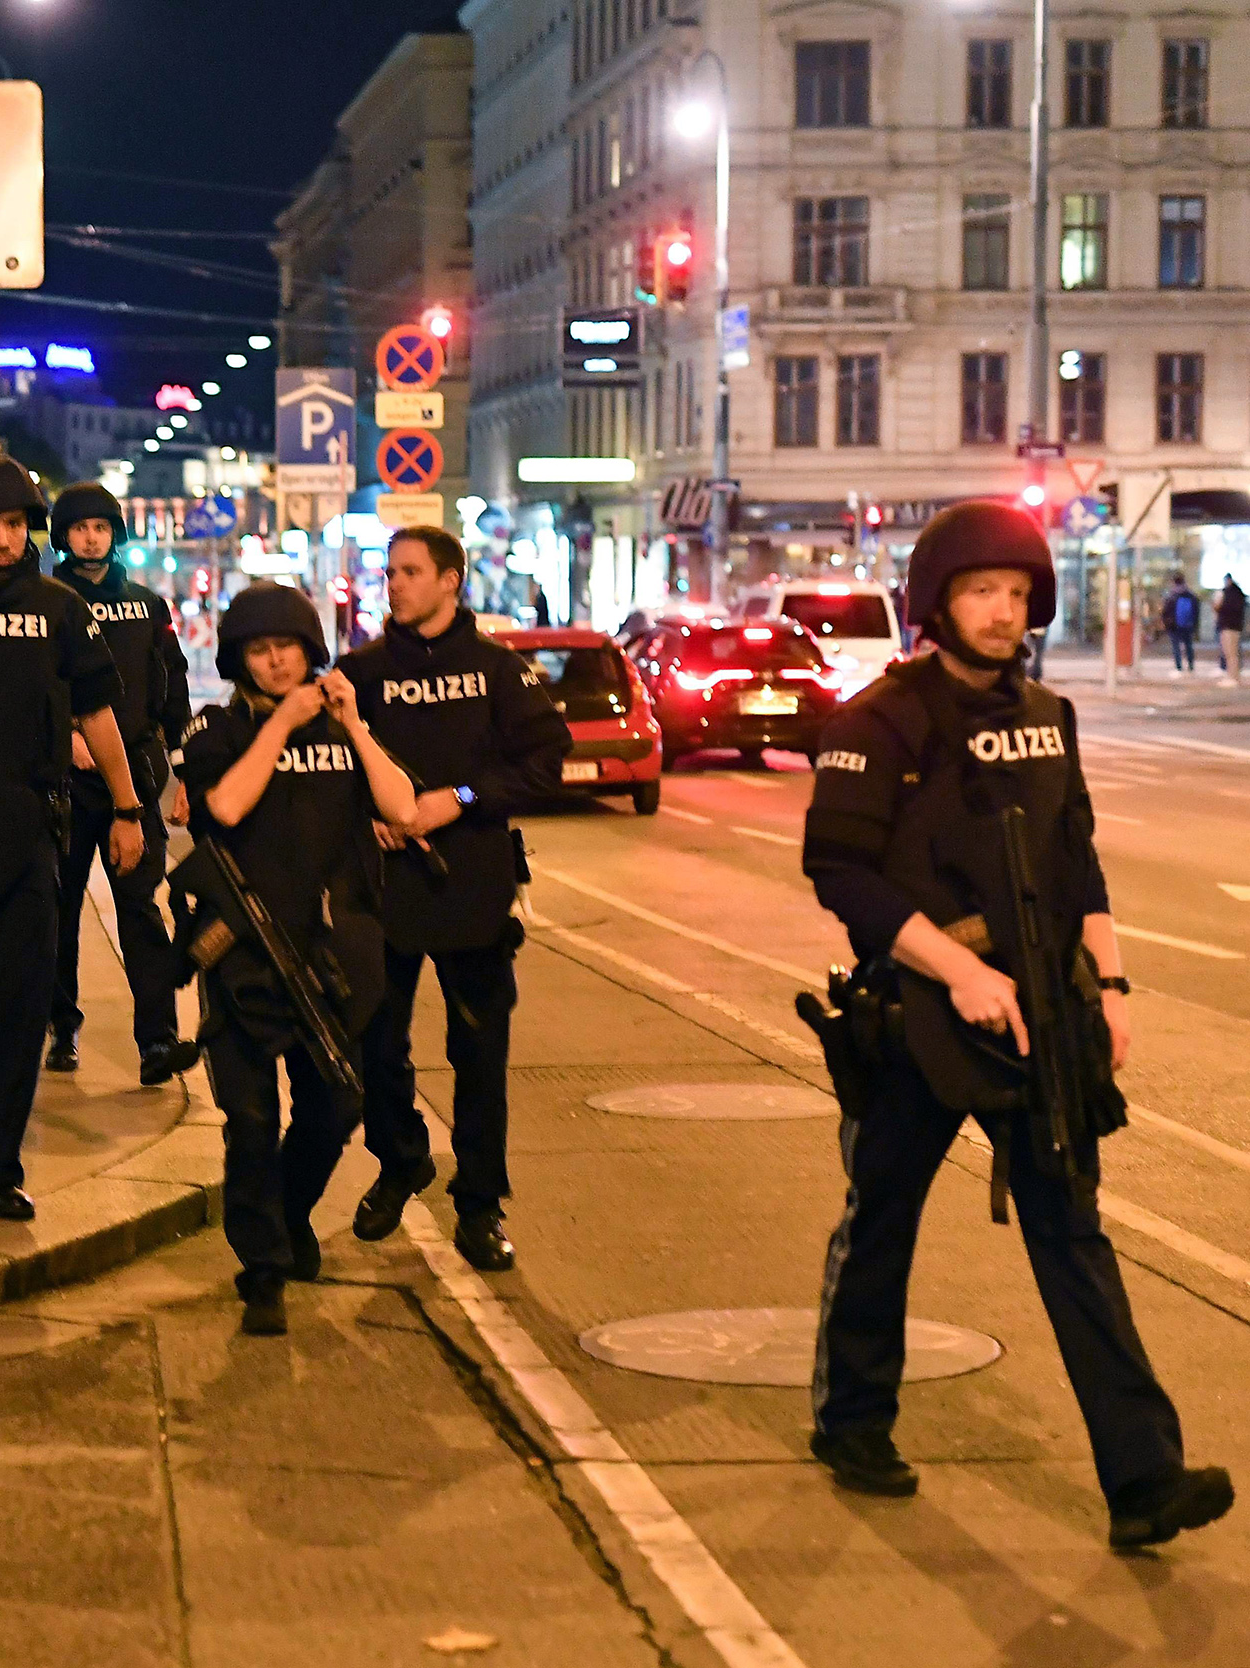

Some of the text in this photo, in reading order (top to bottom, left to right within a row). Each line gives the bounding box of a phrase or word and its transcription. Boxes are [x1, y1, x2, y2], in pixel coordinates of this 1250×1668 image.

[301, 401, 334, 451] P
[86, 601, 150, 622] OLIZEI
[383, 671, 487, 705] POLIZEI
[275, 744, 354, 773] OLIZEI
[967, 725, 1066, 763] OLIZEI
